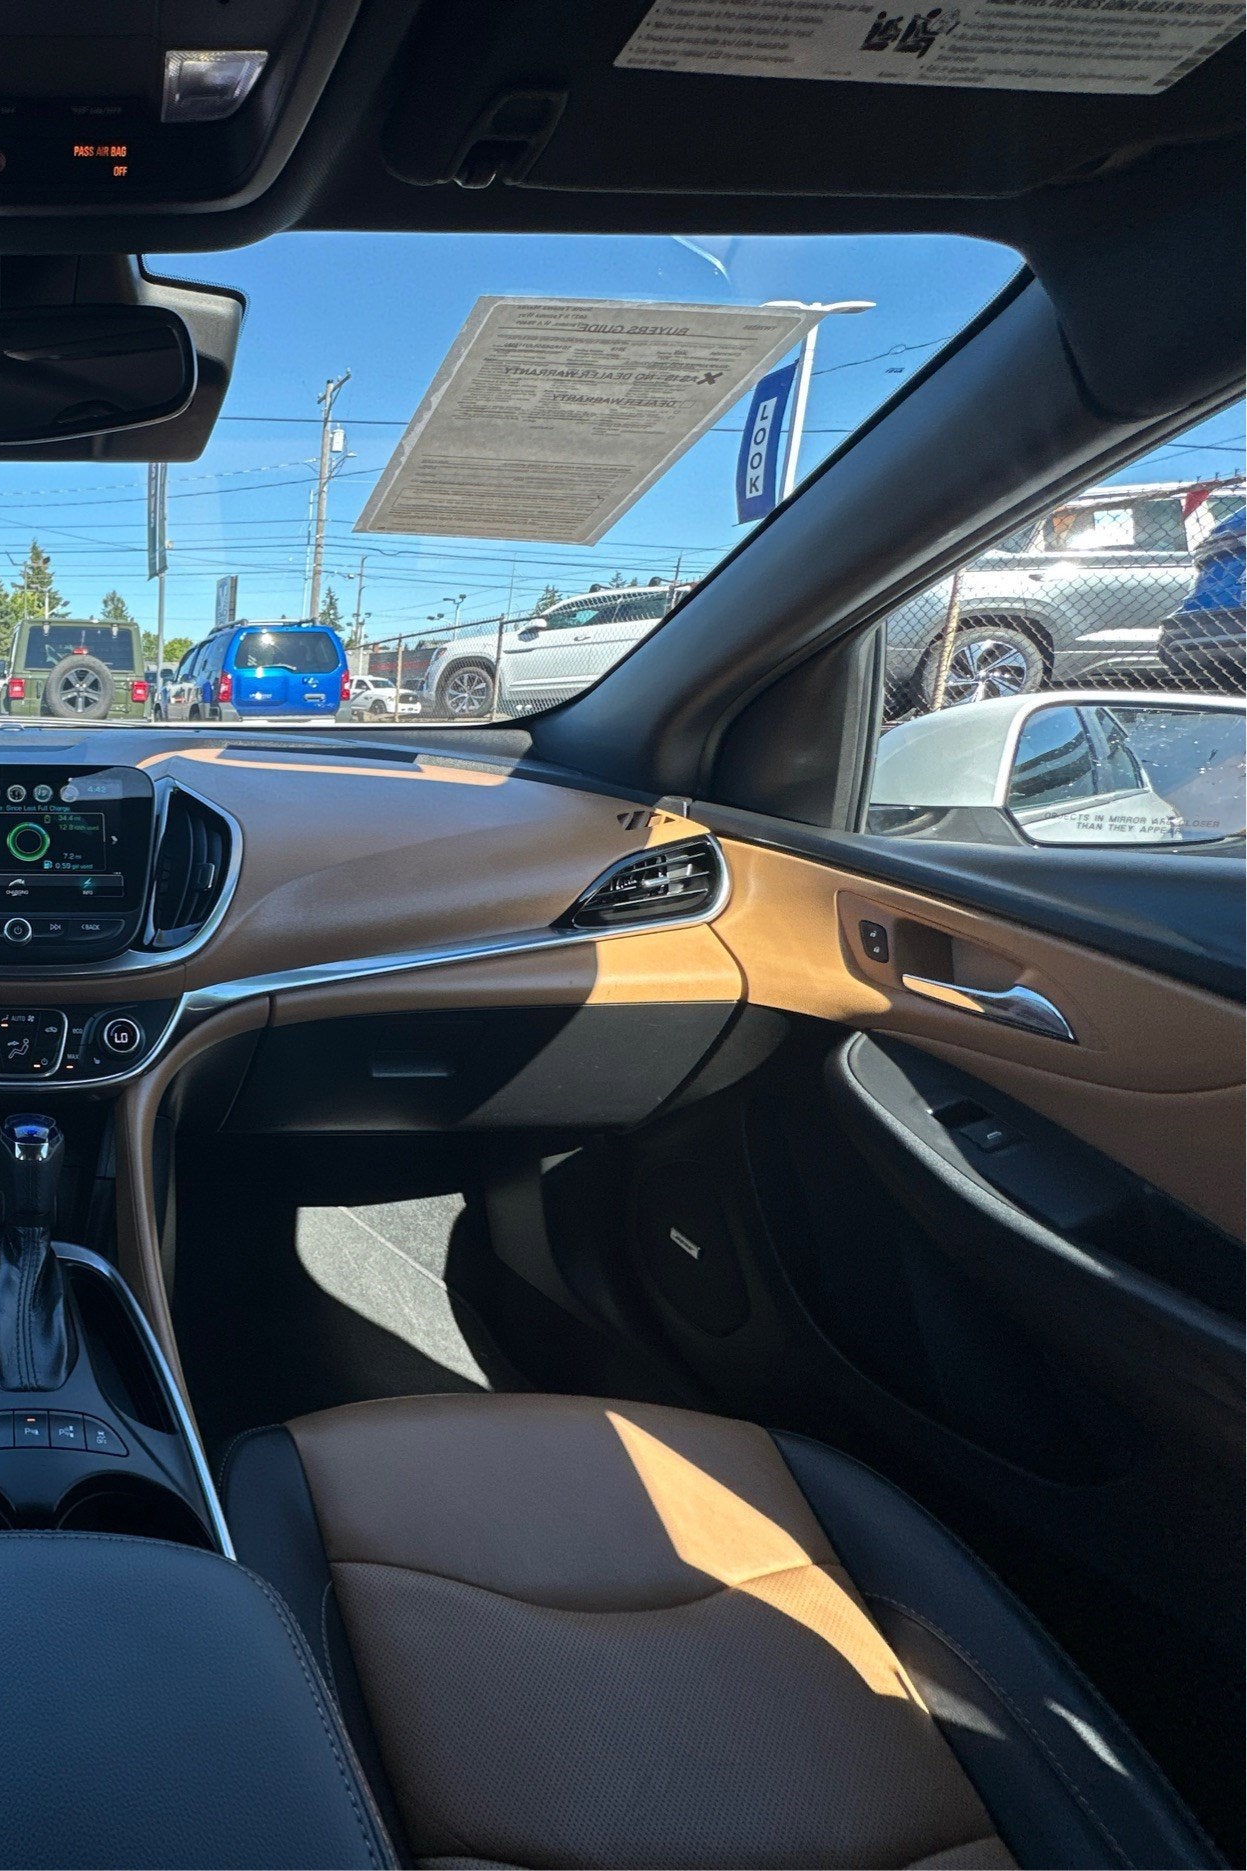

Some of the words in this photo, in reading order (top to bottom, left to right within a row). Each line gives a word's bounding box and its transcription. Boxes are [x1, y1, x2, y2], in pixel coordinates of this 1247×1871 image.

[73, 145, 94, 157] PASS
[95, 145, 109, 157] AIR
[110, 145, 127, 157] BAG
[113, 166, 128, 177] OFF
[748, 404, 768, 494] LOOK
[1043, 811, 1090, 822] OBJECTS
[1094, 814, 1104, 822] IN
[1107, 815, 1147, 825] MIRROR
[1152, 817, 1173, 826] ARE
[1075, 820, 1103, 831] THAN
[1106, 822, 1135, 833] THEY
[1138, 825, 1182, 834] APPEAR
[113, 1032, 129, 1044] LO
